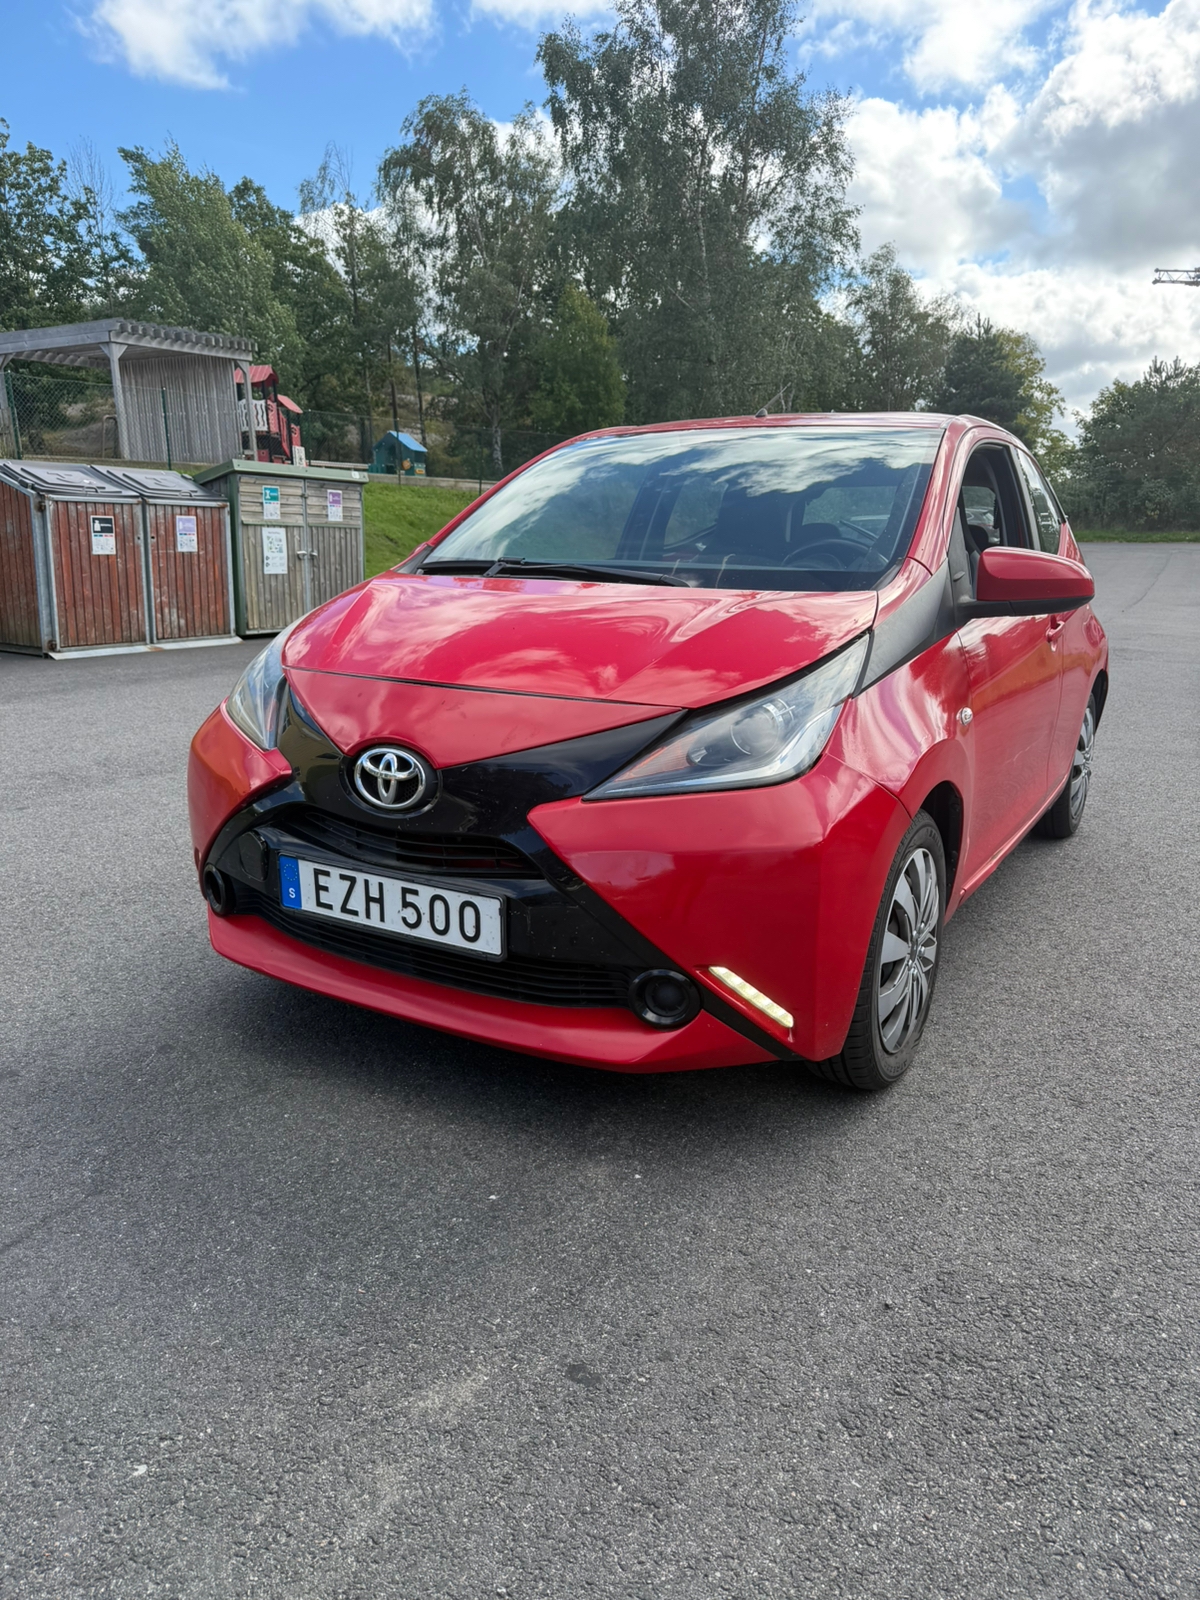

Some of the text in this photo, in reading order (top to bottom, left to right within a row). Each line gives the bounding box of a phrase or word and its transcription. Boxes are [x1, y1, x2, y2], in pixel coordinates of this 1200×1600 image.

[288, 887, 296, 899] S
[313, 868, 481, 943] EZH 500
